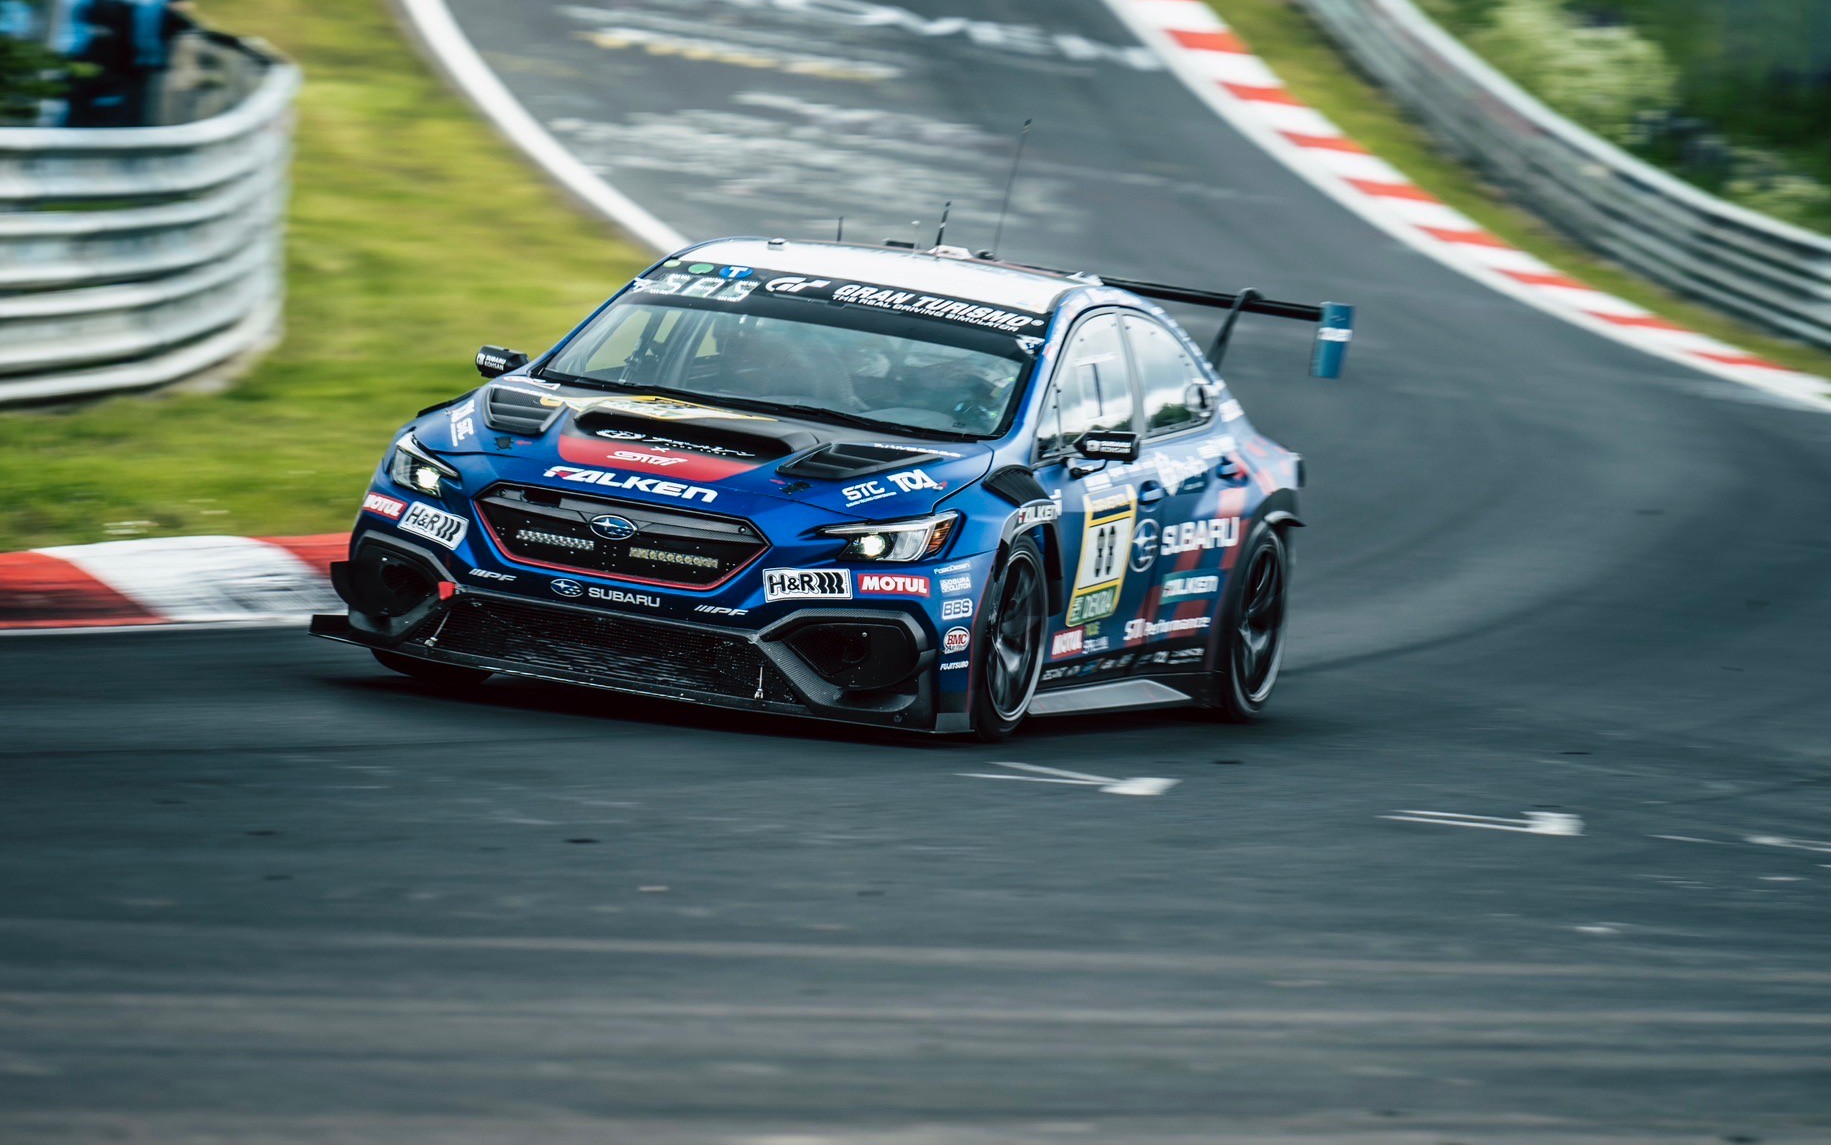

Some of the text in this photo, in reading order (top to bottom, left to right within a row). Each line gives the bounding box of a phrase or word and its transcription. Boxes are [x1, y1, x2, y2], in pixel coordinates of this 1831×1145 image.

[832, 294, 1019, 333] THE REAL DRIVING SIMULATOR
[834, 284, 1034, 327] GRAN TURISMO
[543, 465, 719, 503] FALKEN
[842, 480, 886, 501] STC
[887, 469, 940, 493] TOA
[362, 493, 404, 517] MOTUL
[1160, 516, 1241, 556] SUBARU
[767, 572, 817, 596] H&R
[861, 575, 928, 595] MOTUL
[588, 587, 660, 608] SUBARU
[943, 599, 972, 617] BBS
[946, 633, 968, 645] BMC
[939, 660, 969, 671] FUJITSUBO
